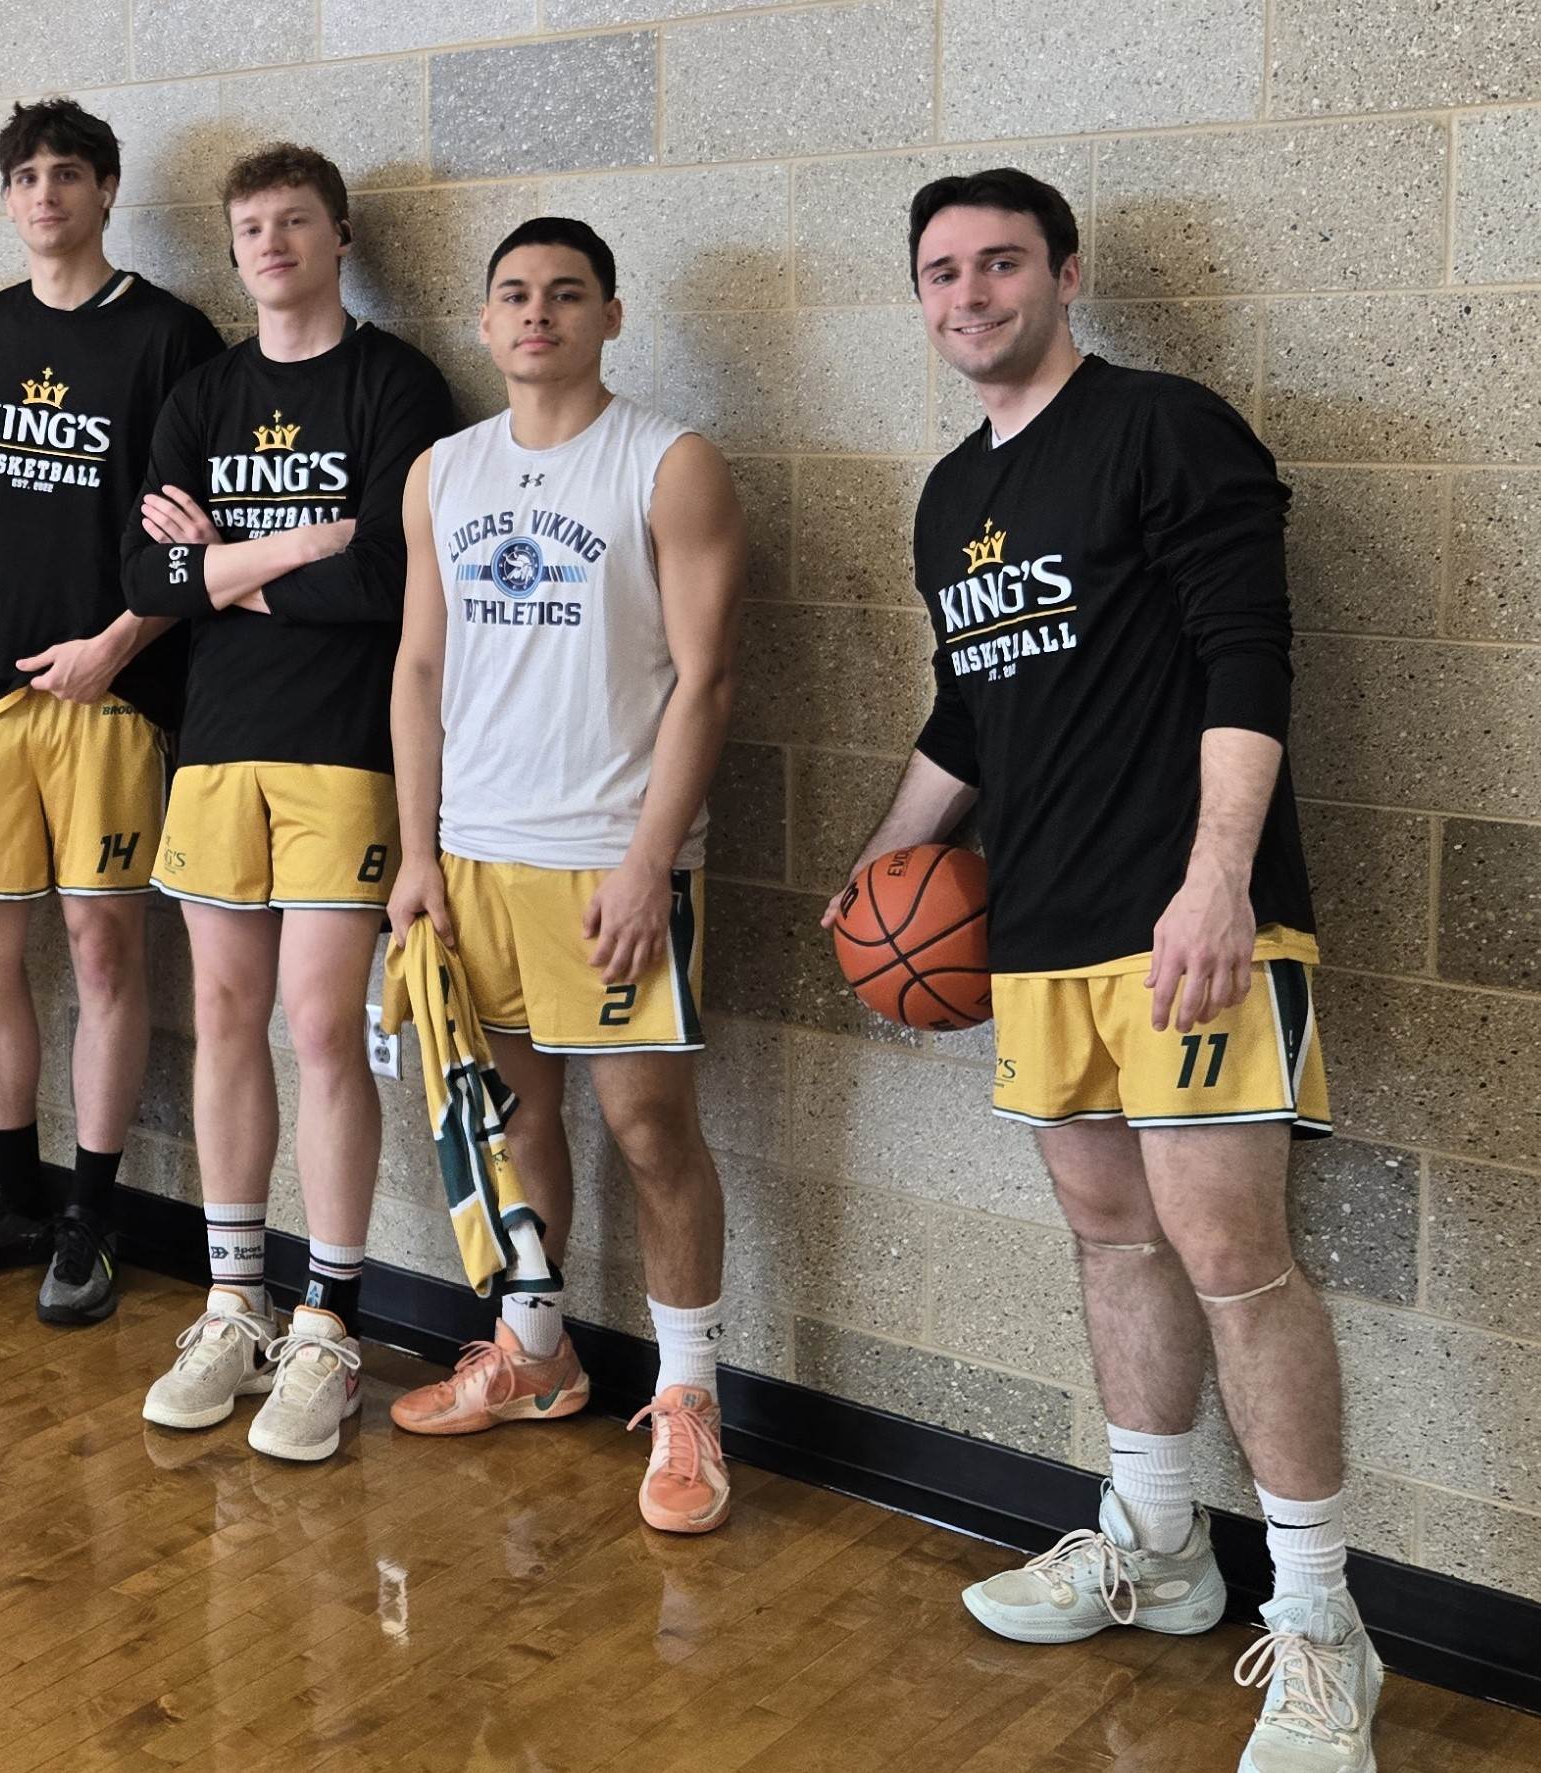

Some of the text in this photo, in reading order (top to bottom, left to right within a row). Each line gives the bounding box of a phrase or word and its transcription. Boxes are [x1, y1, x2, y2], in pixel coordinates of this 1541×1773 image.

[208, 451, 349, 494] KING'S
[447, 509, 607, 563] LUCAS VIKING
[938, 554, 1073, 633] KING'S
[96, 832, 141, 874] 14
[357, 844, 387, 884] 8
[599, 985, 637, 1026] 2
[1177, 1032, 1229, 1089] 11
